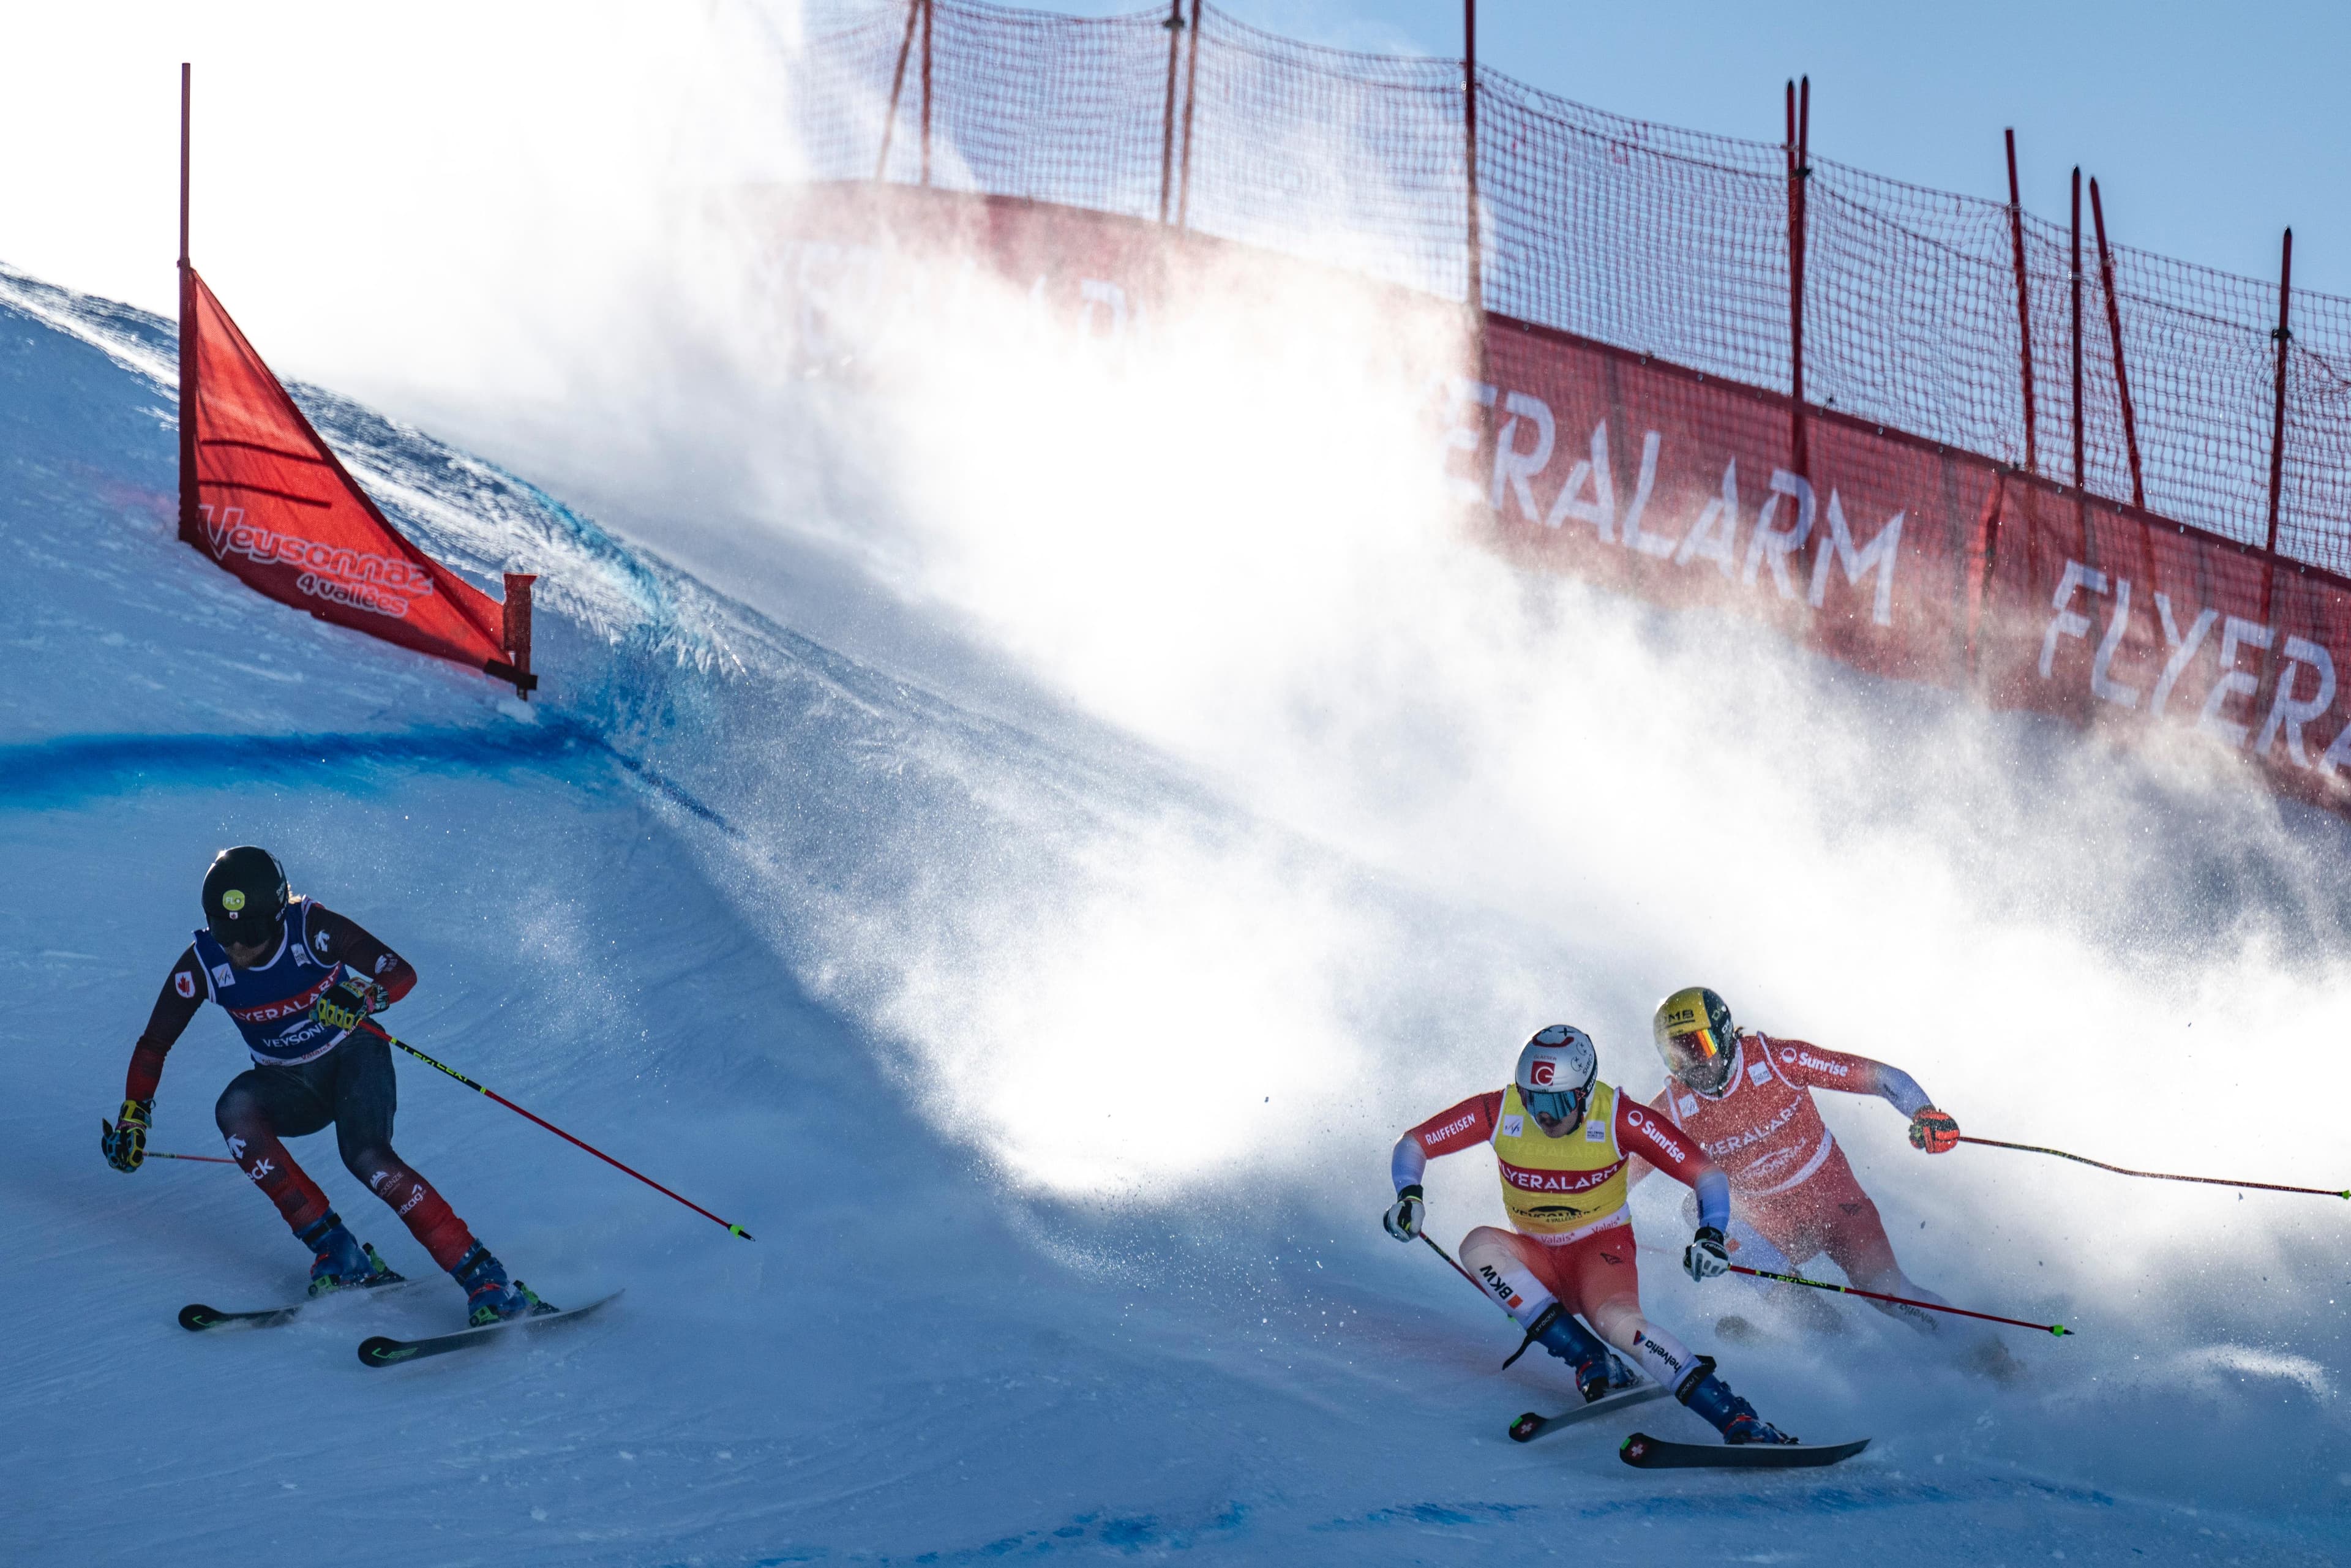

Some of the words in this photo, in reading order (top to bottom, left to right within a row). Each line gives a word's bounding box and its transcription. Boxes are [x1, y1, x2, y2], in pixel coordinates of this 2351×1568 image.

[1798, 1051, 1848, 1077] Sunrise
[1425, 1113, 1476, 1146] RAIFFEISEN
[1641, 1120, 1685, 1163] Sunrise
[1479, 1265, 1514, 1300] BKW
[1644, 1340, 1682, 1374] helvetia
